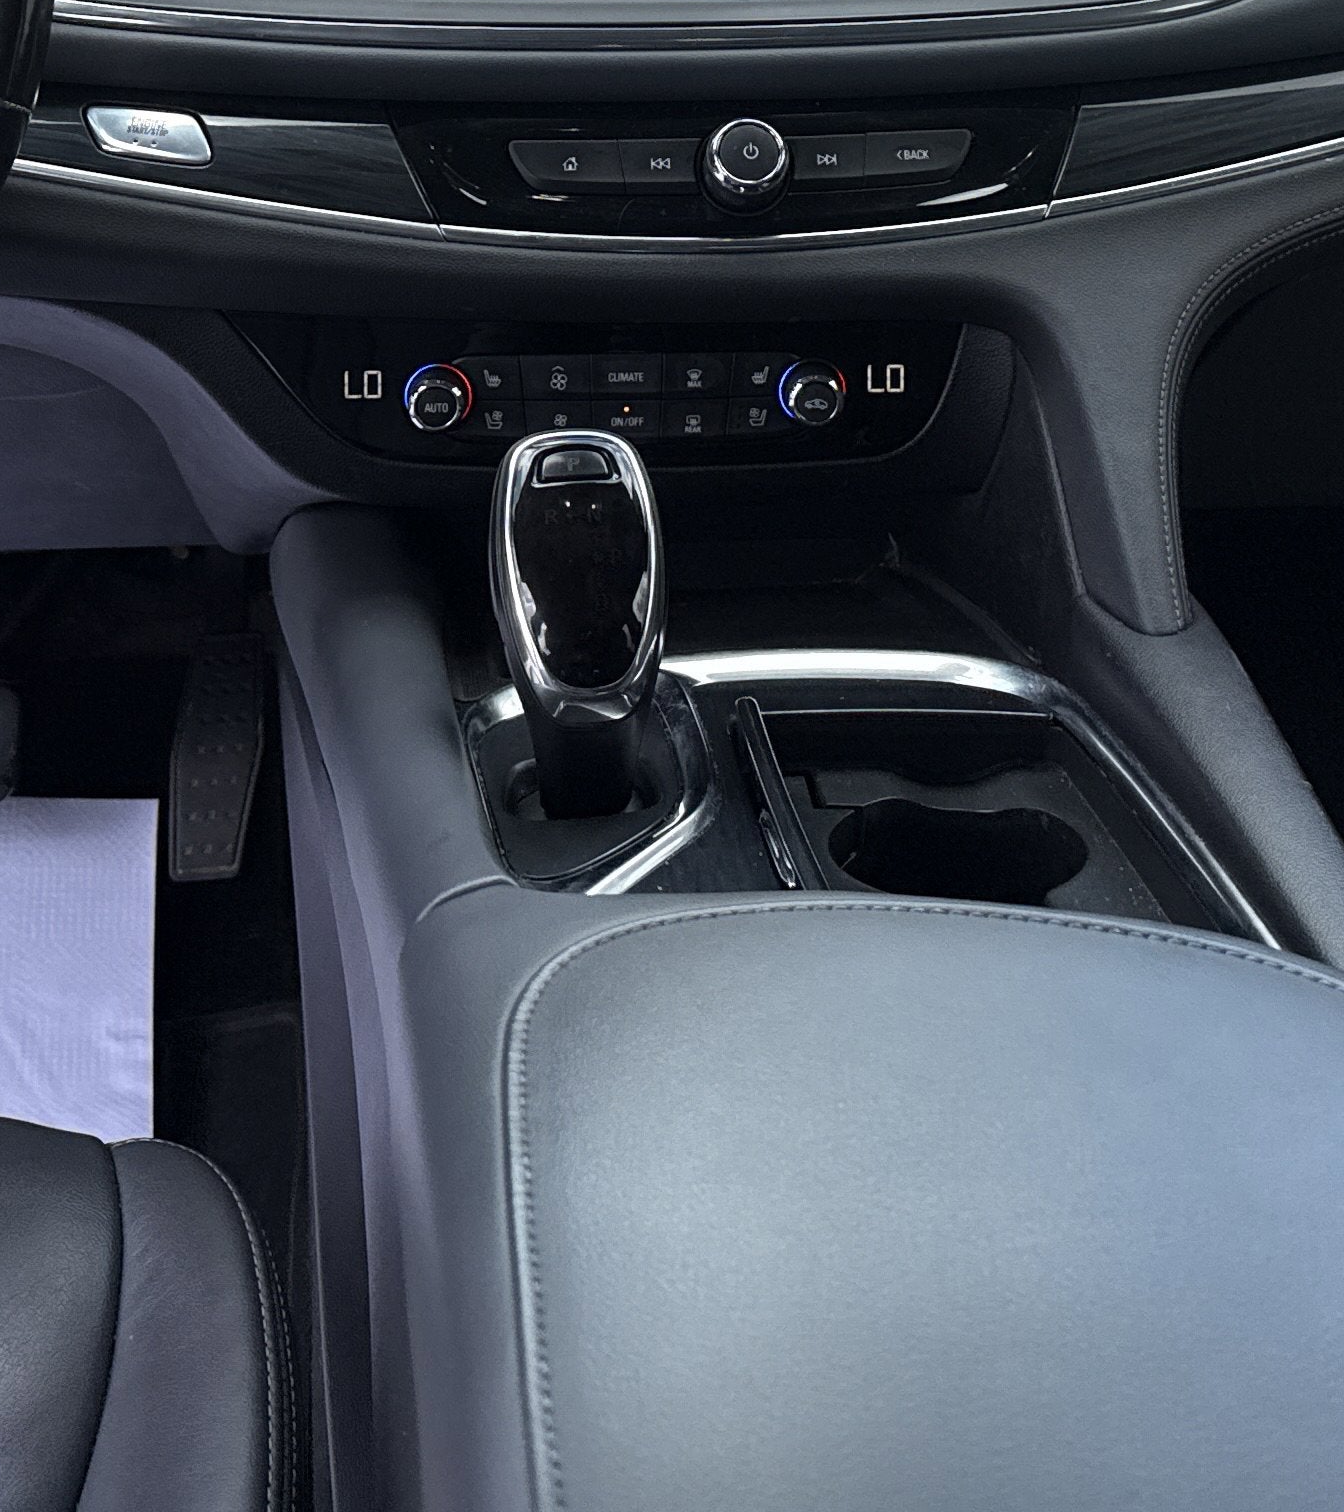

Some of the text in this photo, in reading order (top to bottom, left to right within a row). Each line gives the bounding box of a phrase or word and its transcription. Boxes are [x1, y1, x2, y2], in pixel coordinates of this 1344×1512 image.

[608, 372, 644, 383] CLIMATE
[866, 364, 905, 393] LO
[343, 370, 383, 399] LO
[424, 402, 449, 414] AUTO
[610, 416, 644, 428] ON/OFF
